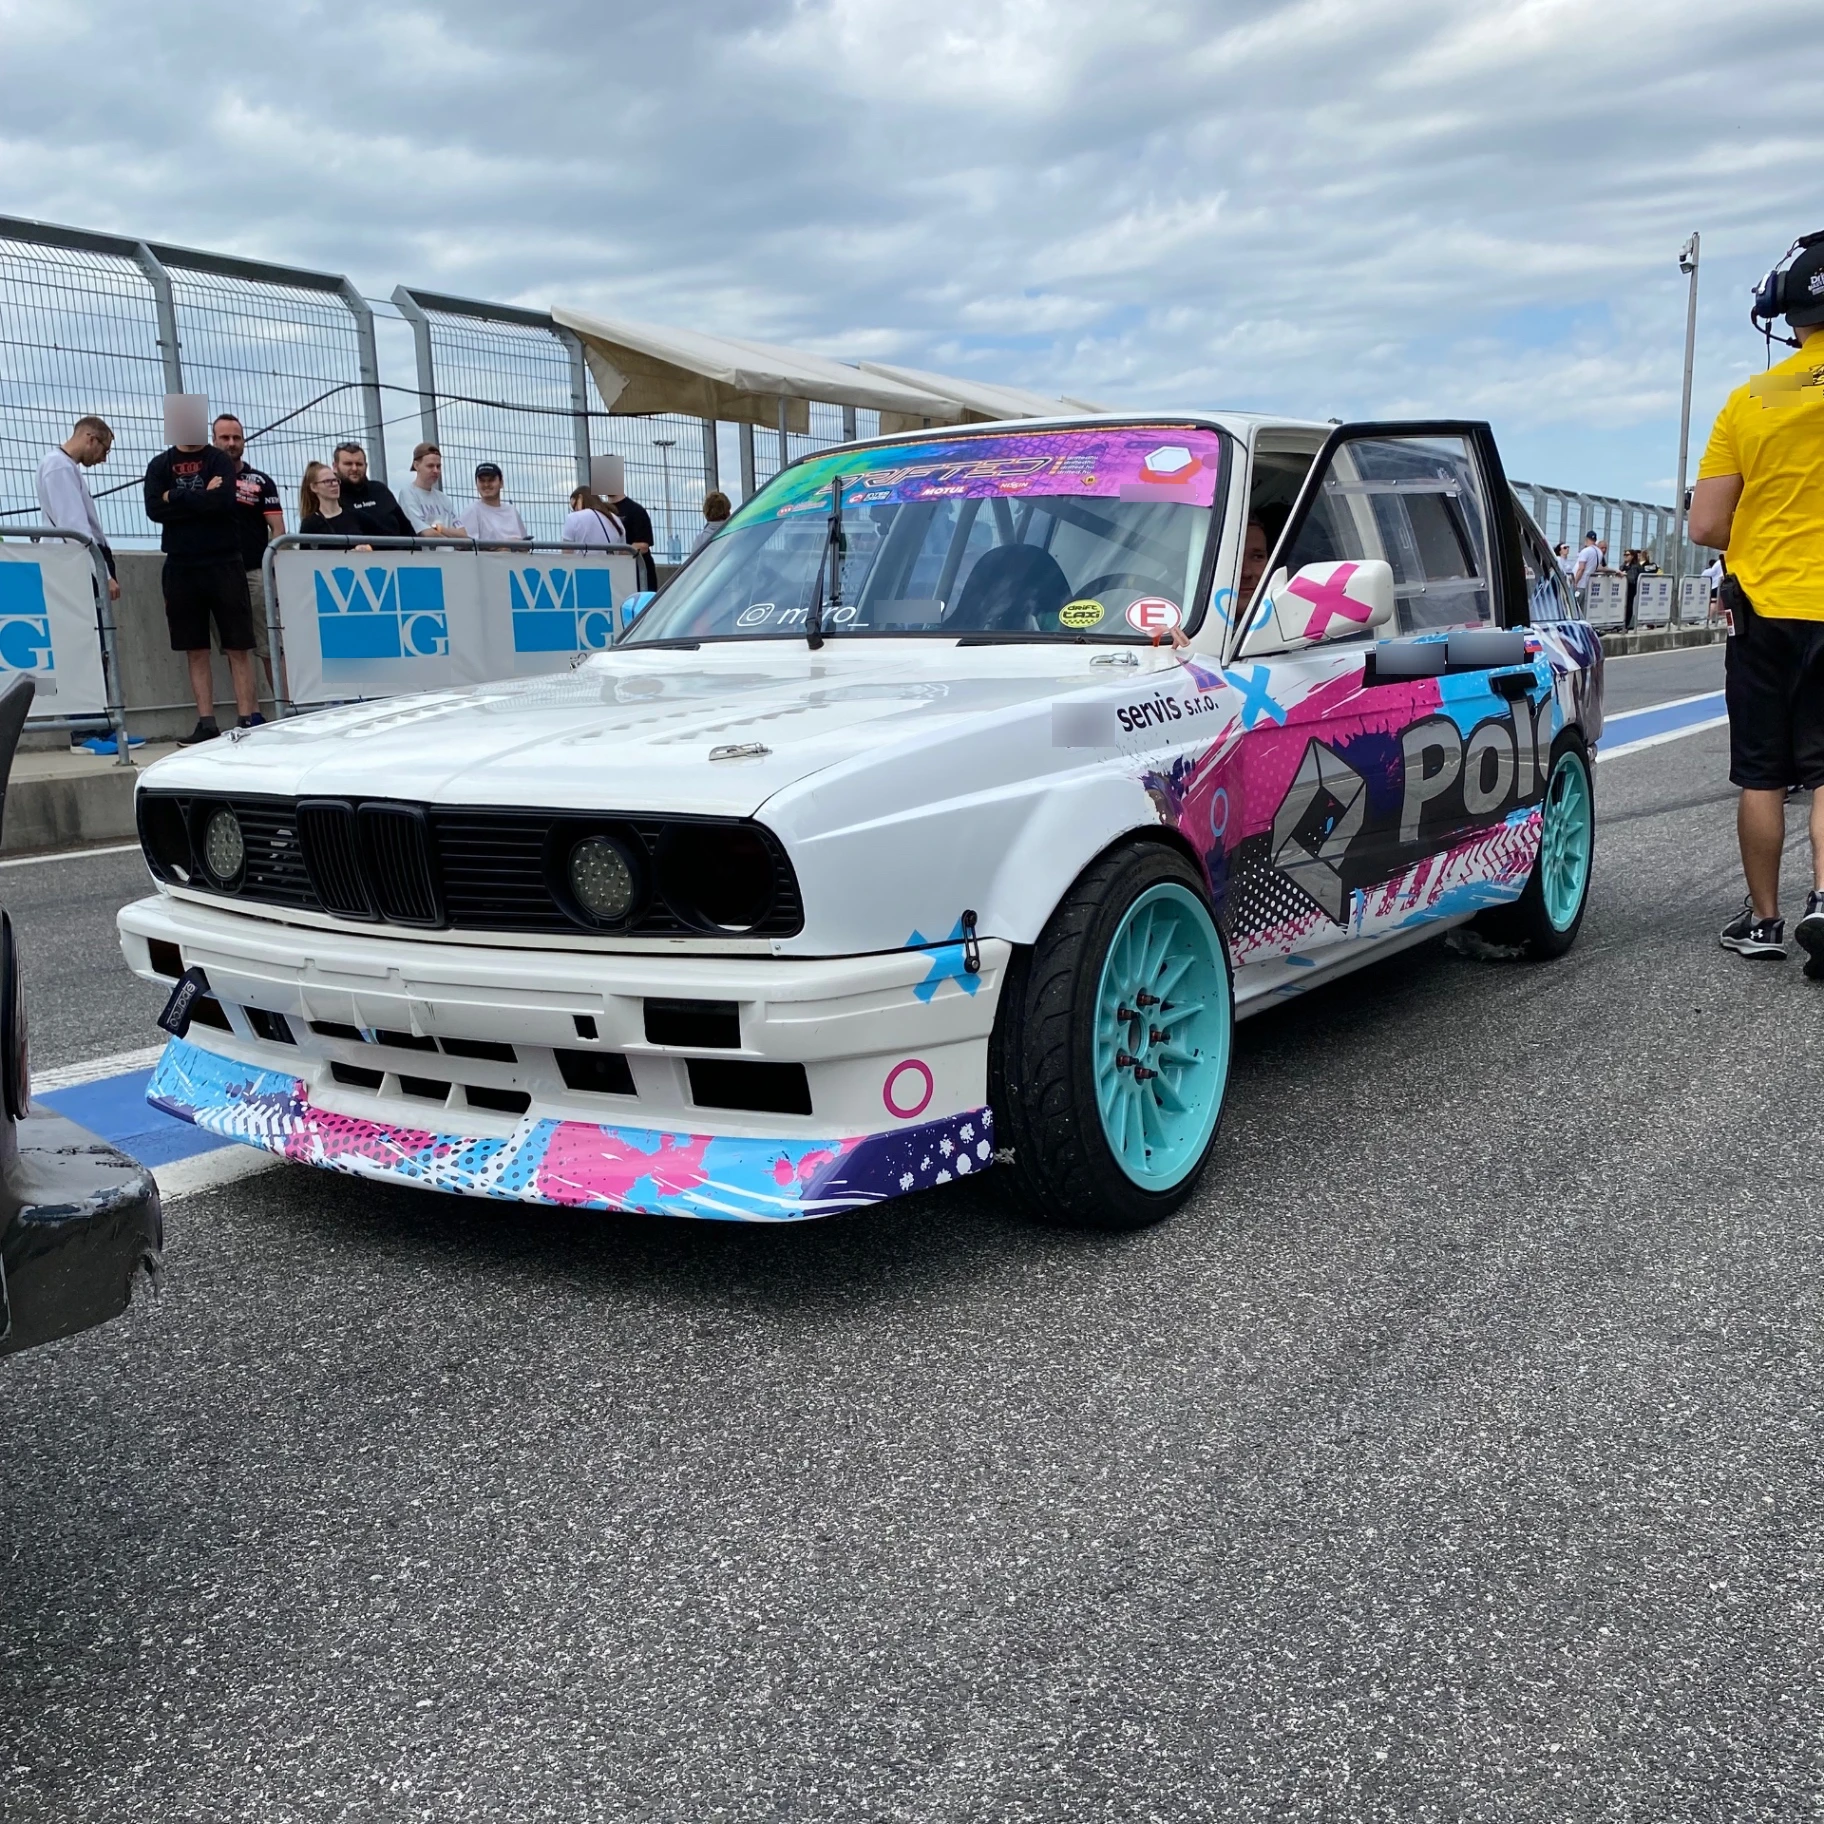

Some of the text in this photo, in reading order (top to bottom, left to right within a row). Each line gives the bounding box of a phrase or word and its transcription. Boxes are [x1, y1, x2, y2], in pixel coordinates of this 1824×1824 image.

[921, 484, 965, 496] MOTUL
[1000, 481, 1029, 490] NISSIN
[777, 602, 870, 627] mro_
[1140, 603, 1168, 628] E
[1116, 692, 1219, 732] servis s.r.o.
[168, 981, 197, 1028] sparco
